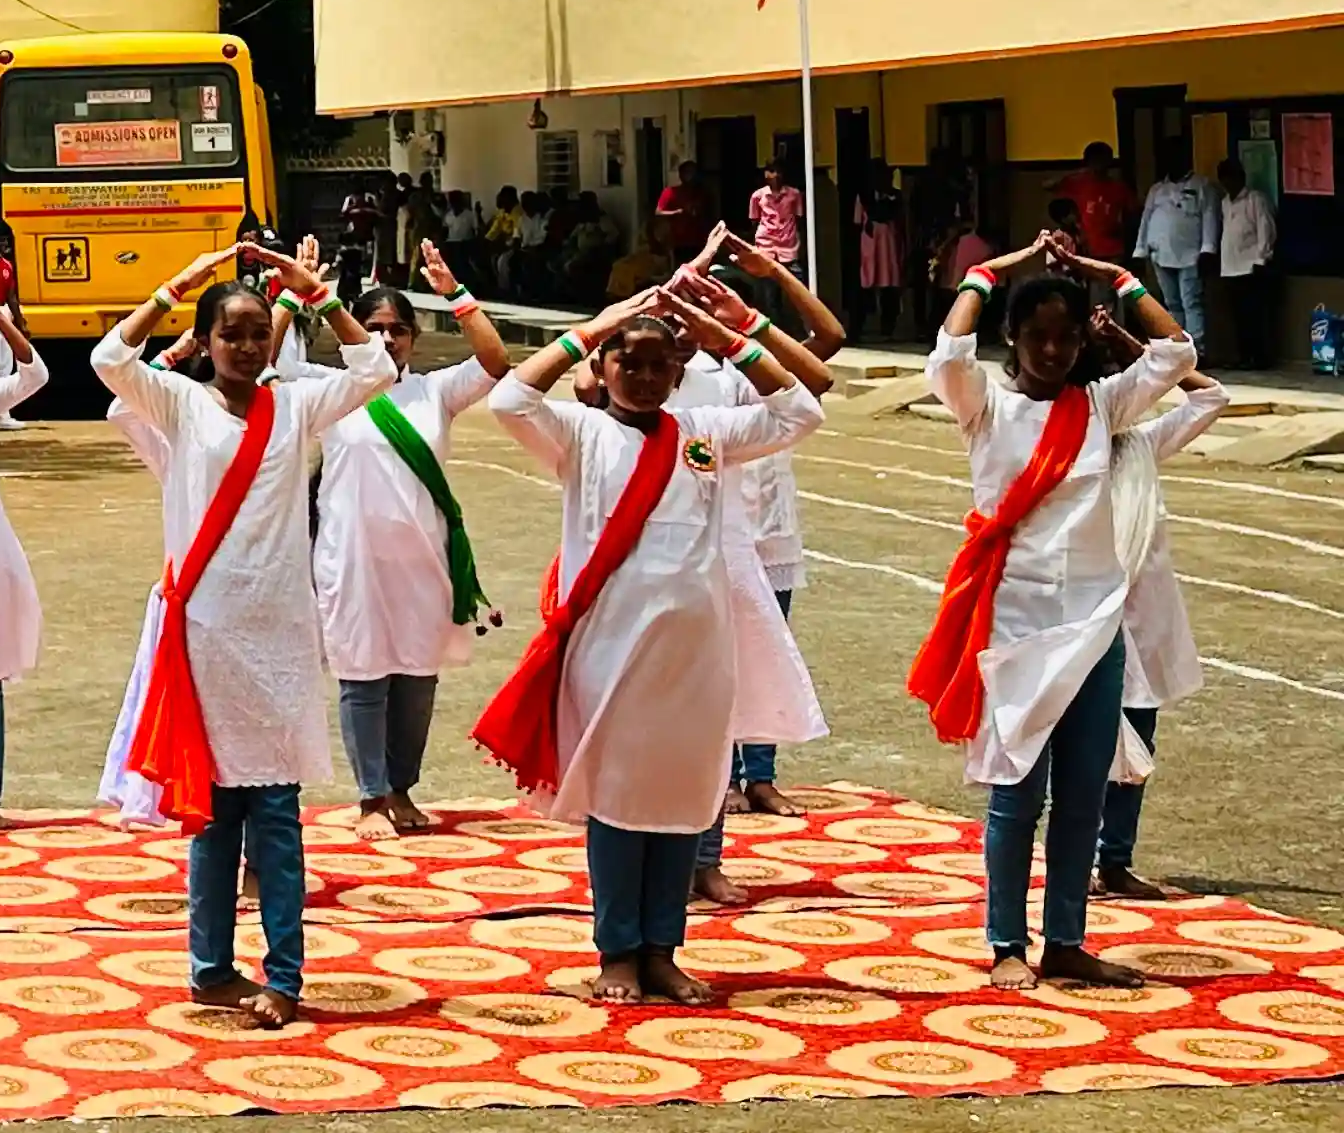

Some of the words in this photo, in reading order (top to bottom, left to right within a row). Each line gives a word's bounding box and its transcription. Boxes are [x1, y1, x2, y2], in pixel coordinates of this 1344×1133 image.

[75, 127, 146, 143] ADMISSIONS
[149, 126, 177, 141] OPEN
[207, 136, 216, 149] 1
